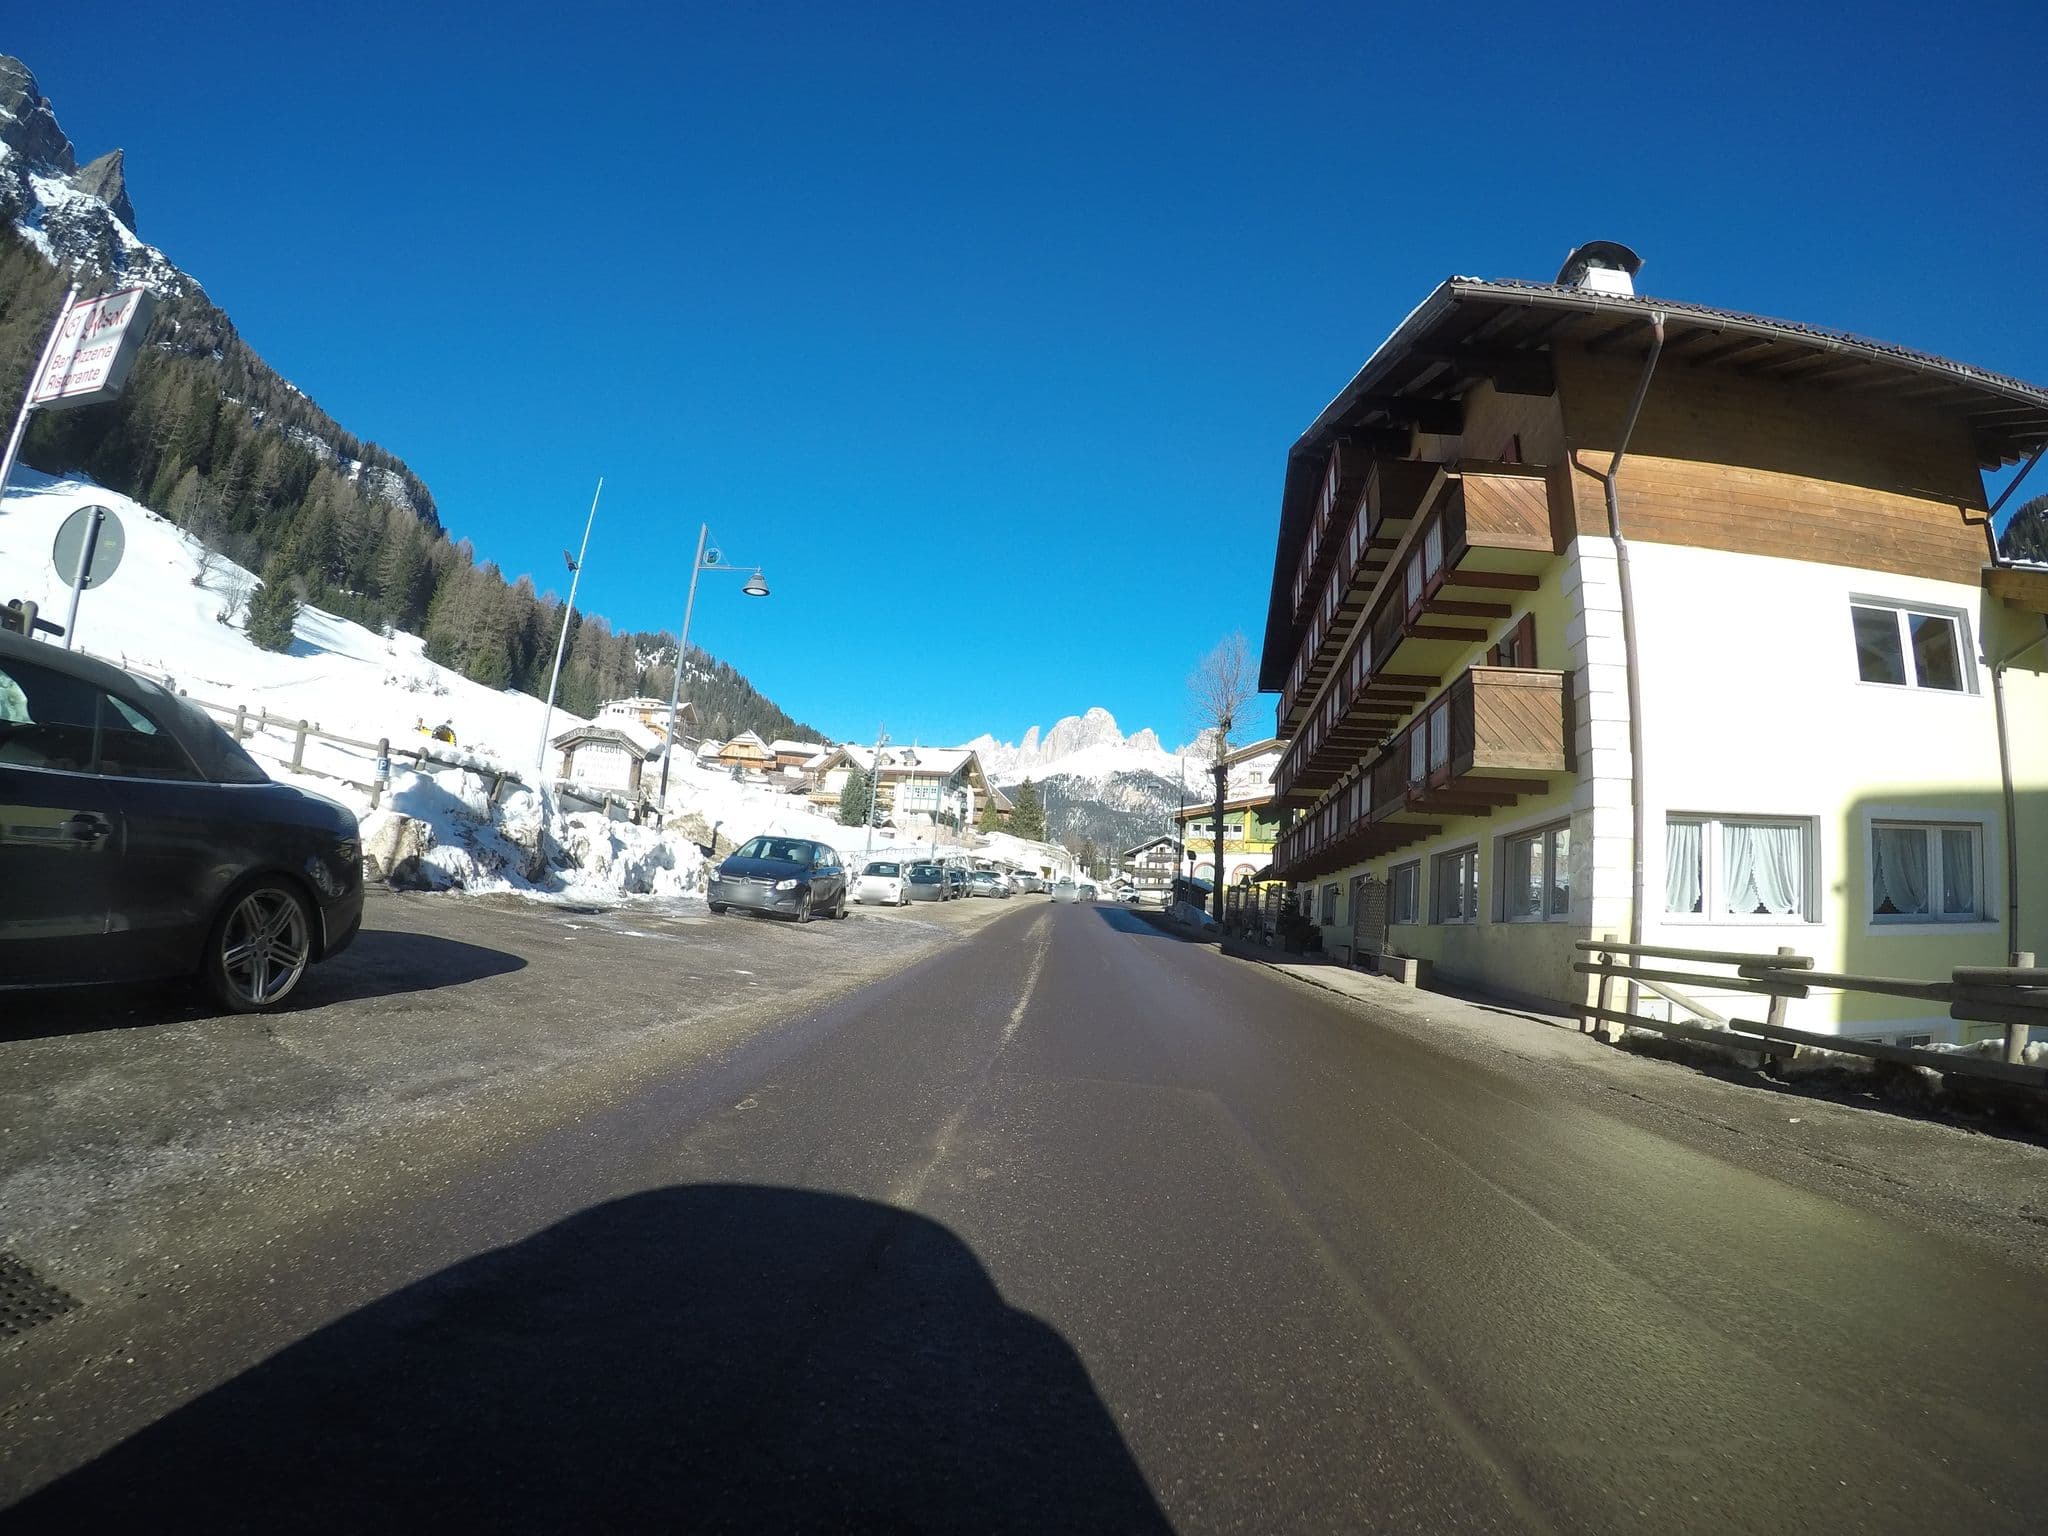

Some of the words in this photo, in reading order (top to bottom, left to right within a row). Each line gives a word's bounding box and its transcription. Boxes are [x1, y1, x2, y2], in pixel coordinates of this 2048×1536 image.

[51, 354, 72, 370] Bar
[71, 345, 112, 366] Pizzeria
[46, 368, 101, 390] Ristorante
